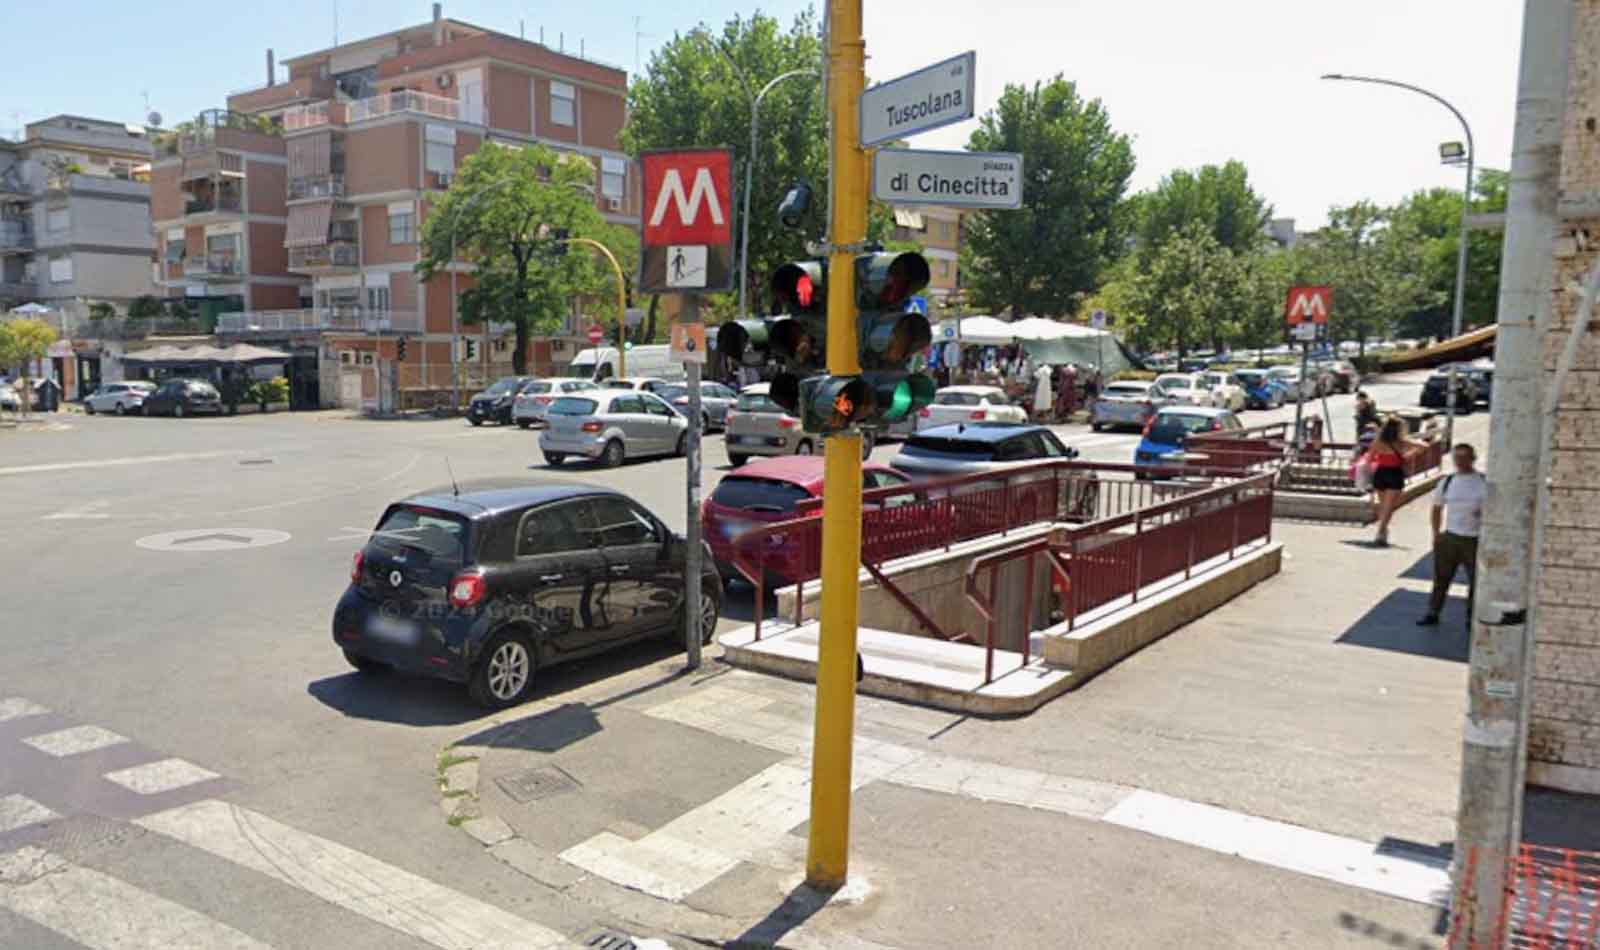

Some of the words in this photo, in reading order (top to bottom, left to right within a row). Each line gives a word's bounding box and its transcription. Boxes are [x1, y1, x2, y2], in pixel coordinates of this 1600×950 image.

[951, 66, 962, 77] via
[886, 89, 962, 126] Tuscolana
[890, 173, 908, 192] di
[650, 168, 725, 226] M
[1289, 293, 1326, 316] M
